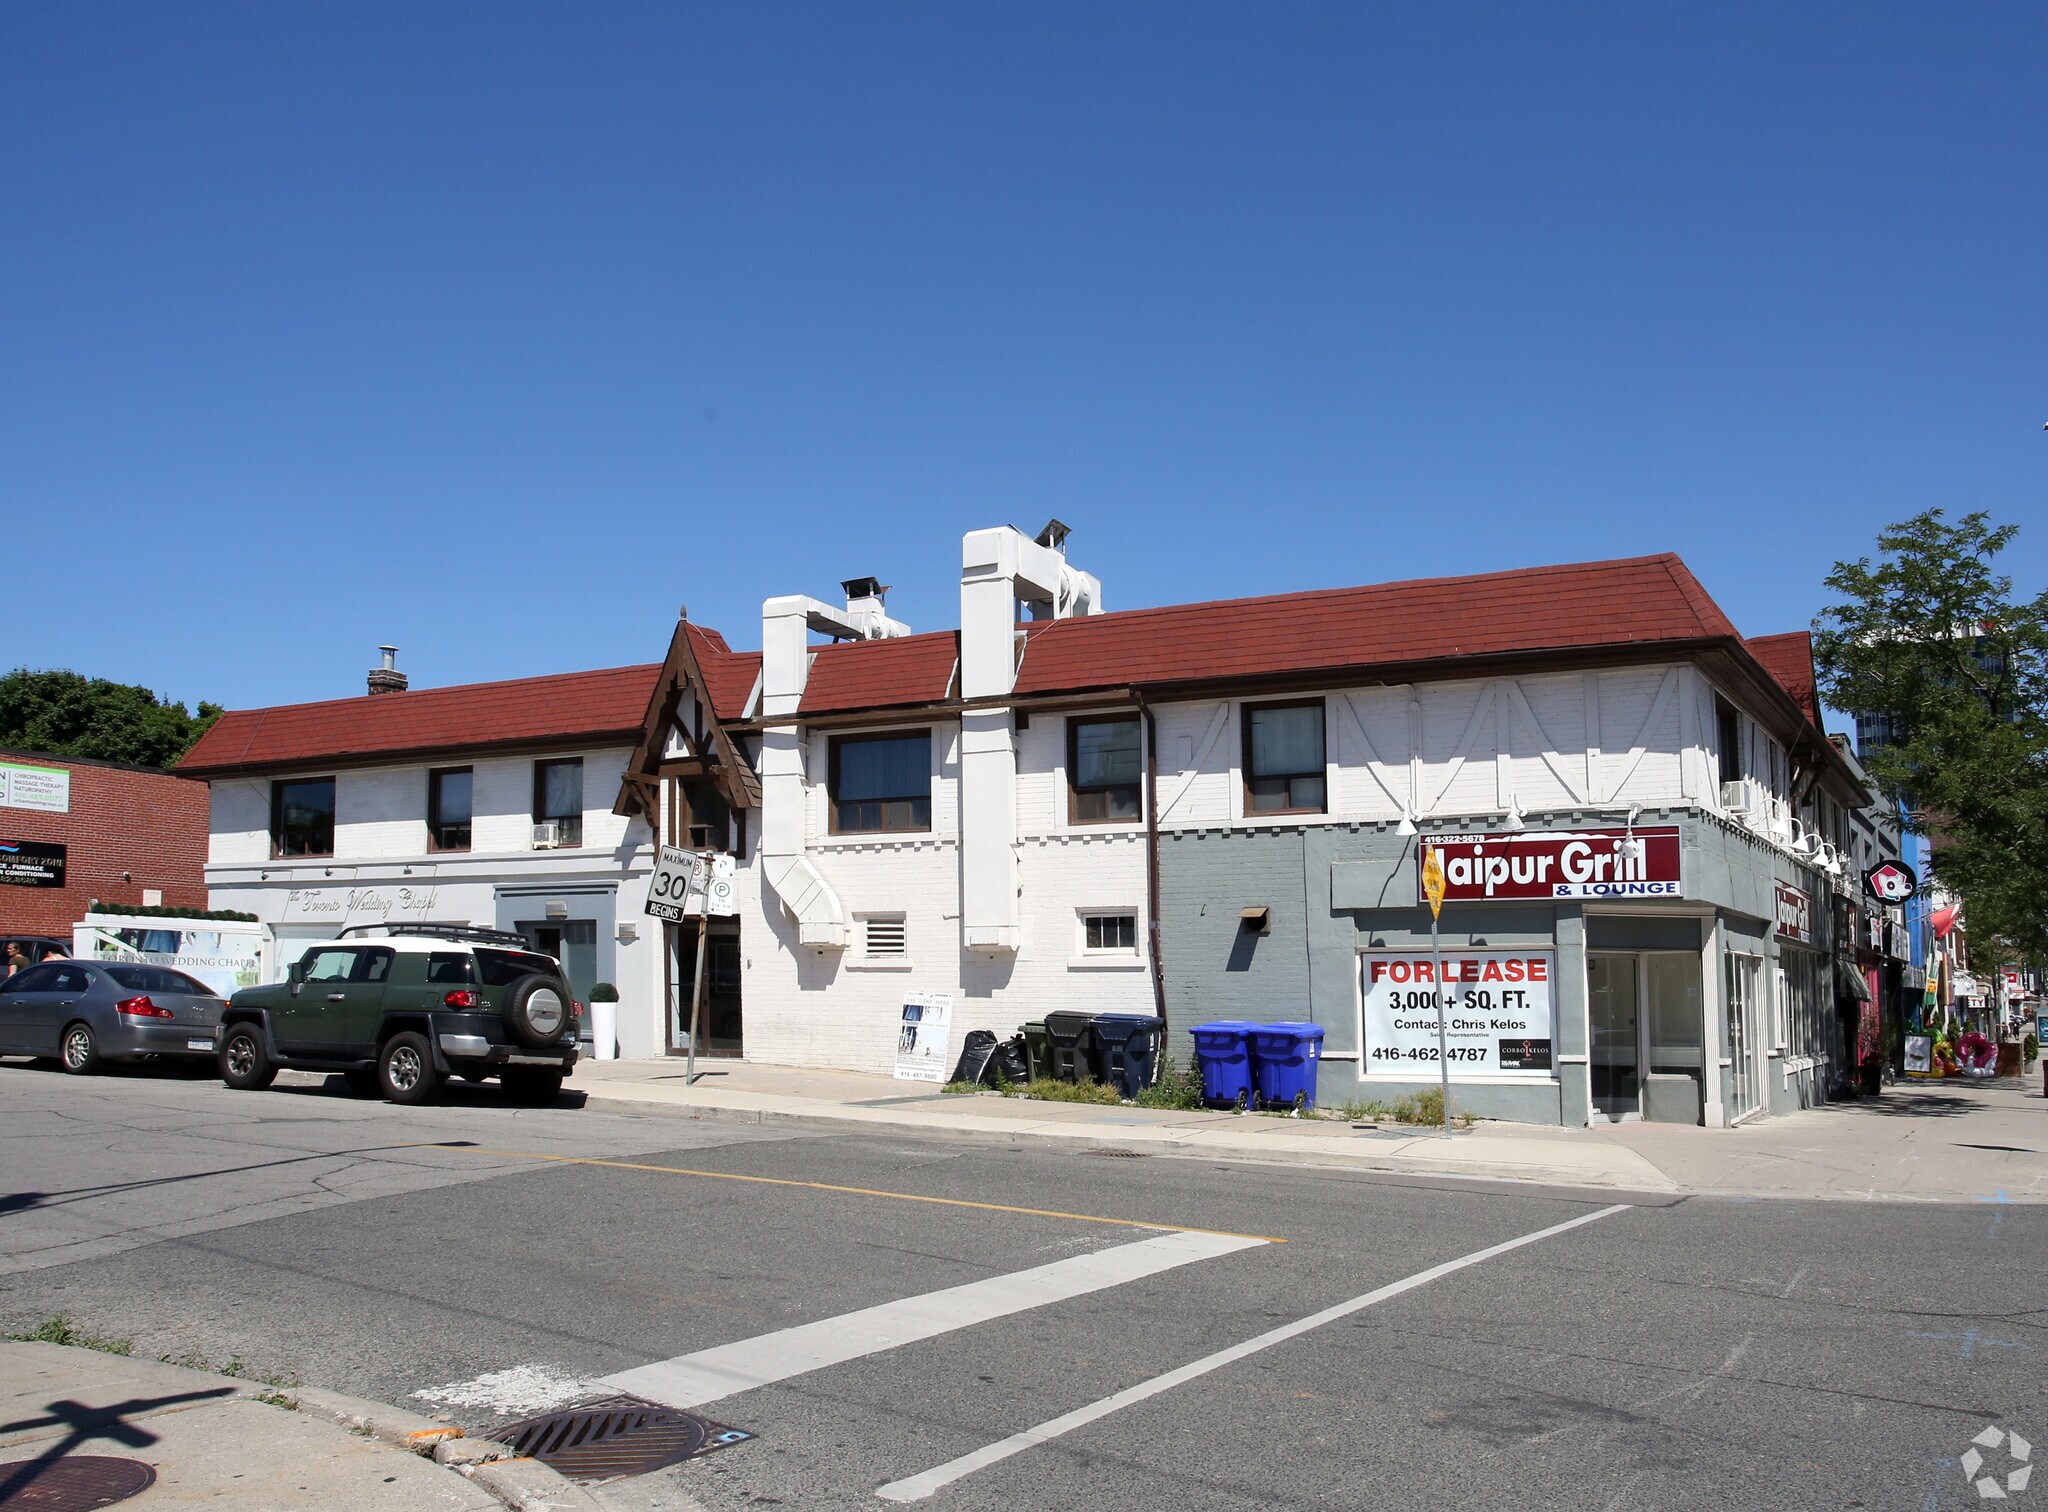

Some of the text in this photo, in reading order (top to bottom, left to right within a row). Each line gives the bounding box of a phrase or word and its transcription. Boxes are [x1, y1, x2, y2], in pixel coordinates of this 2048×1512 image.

[15, 773, 53, 782] CHIROPRACTIC
[14, 786, 53, 794] NATUROPATHY
[40, 782, 64, 790] THERAPY
[0, 855, 40, 865] OMFORT
[663, 853, 693, 868] MAXIMUM
[1560, 838, 1647, 884] Grill
[5, 870, 55, 878] CONDITIONING
[12, 864, 44, 872] FURNACE
[654, 871, 687, 900] 30
[1555, 882, 1677, 896] & LOUNGE
[302, 890, 341, 912] Toronto
[347, 889, 394, 918] Wedding
[399, 887, 439, 916] Chapel
[649, 902, 679, 920] BEGINS
[1776, 890, 1797, 935] Jaipur
[161, 955, 216, 966] WEDDING
[217, 958, 257, 967] CHAPEL
[1370, 958, 1548, 983] FOR LEASE
[1464, 990, 1498, 1011] SQ.
[1502, 990, 1531, 1009] FT.
[1394, 1018, 1527, 1029] Contac: Chris Kelos
[1372, 1048, 1488, 1061] 416-4624787
